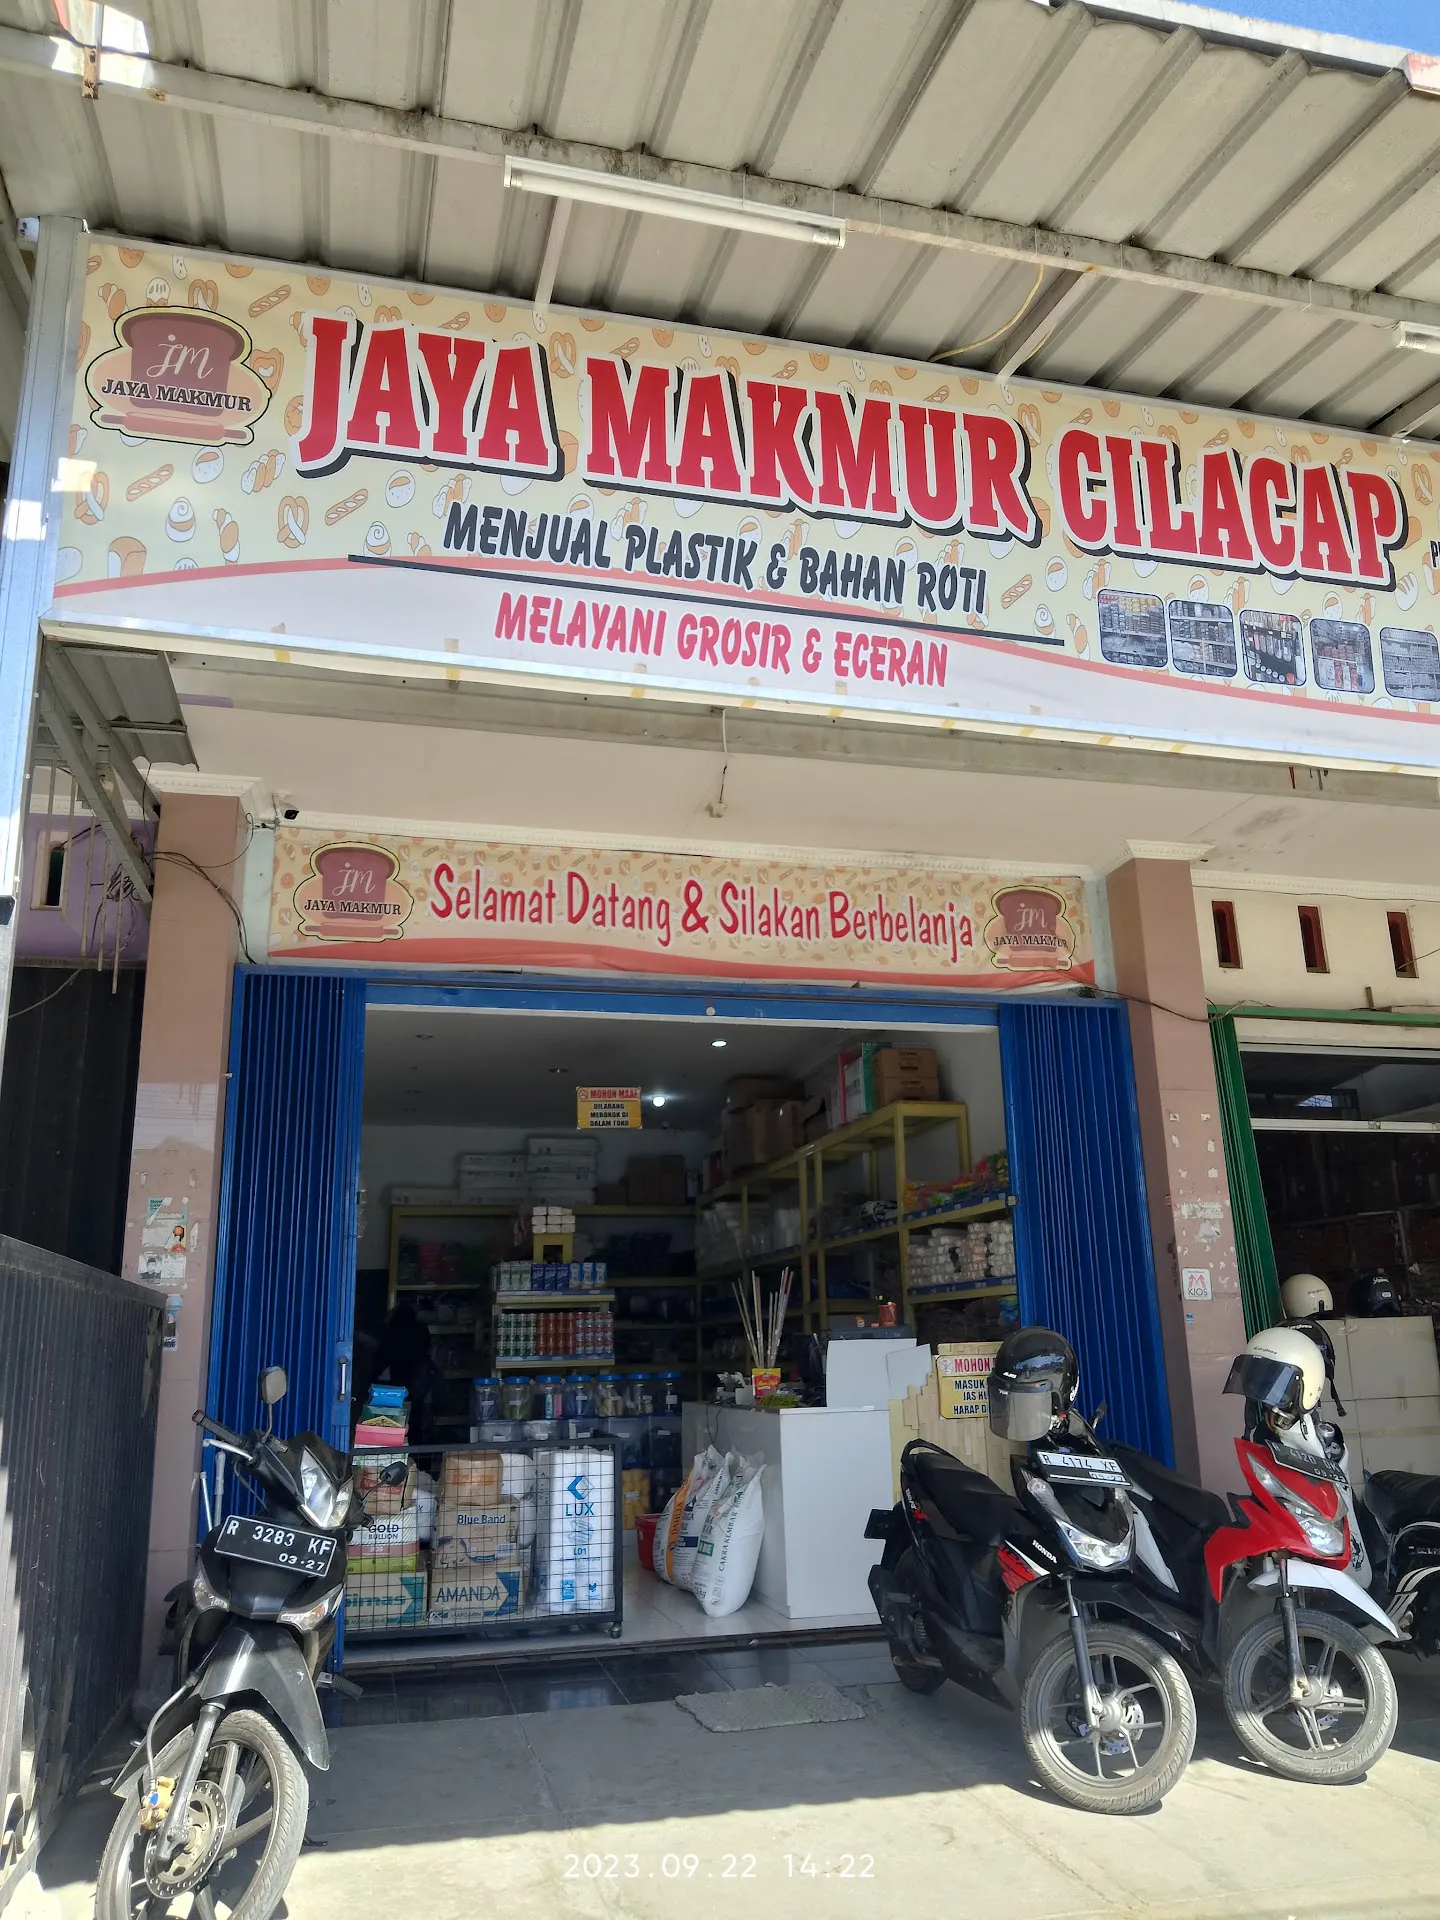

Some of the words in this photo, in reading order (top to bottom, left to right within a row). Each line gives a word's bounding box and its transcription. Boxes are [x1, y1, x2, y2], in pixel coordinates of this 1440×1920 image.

[102, 378, 151, 399] JAYA
[156, 384, 252, 413] MAKMUR
[298, 316, 556, 468] JAYA
[586, 356, 1032, 535] MAKMUR
[1058, 429, 1399, 580] CILACAP
[443, 502, 611, 567] MENJUAL
[627, 524, 755, 587] PLASTIK
[766, 549, 788, 588] &
[799, 547, 906, 604] BAHAN
[916, 560, 987, 615] ROTI
[495, 592, 668, 657] MELAYANI
[676, 622, 791, 674] GROSIR
[802, 634, 823, 669] &
[834, 631, 948, 689] ECERAN
[304, 899, 336, 912] JAYA
[339, 901, 402, 916] MAKMUR
[430, 862, 556, 925] Selamat
[567, 871, 671, 947] Datang
[681, 879, 709, 933] &
[719, 880, 820, 940] Silakan
[829, 890, 973, 964] Berbelanja
[993, 934, 1020, 947] JAYA
[1022, 934, 1069, 950] MAKMUR
[590, 1090, 617, 1099] MOHON
[618, 1089, 638, 1099] MAAF
[1188, 1288, 1208, 1296] KIOS
[954, 1358, 991, 1372] MOHON
[954, 1379, 985, 1390] MASUK
[963, 1391, 977, 1401] JAS
[953, 1404, 979, 1414] HARAP
[1043, 1454, 1051, 1464] R
[565, 1503, 595, 1517] LUX
[458, 1515, 479, 1524] Blue
[482, 1514, 506, 1524] Band
[368, 1524, 399, 1533] GOLD
[226, 1520, 240, 1536] R
[253, 1525, 296, 1547] 3283
[307, 1538, 332, 1556] KF
[1031, 1539, 1058, 1564] HONDA
[435, 1586, 501, 1603] AMANDA
